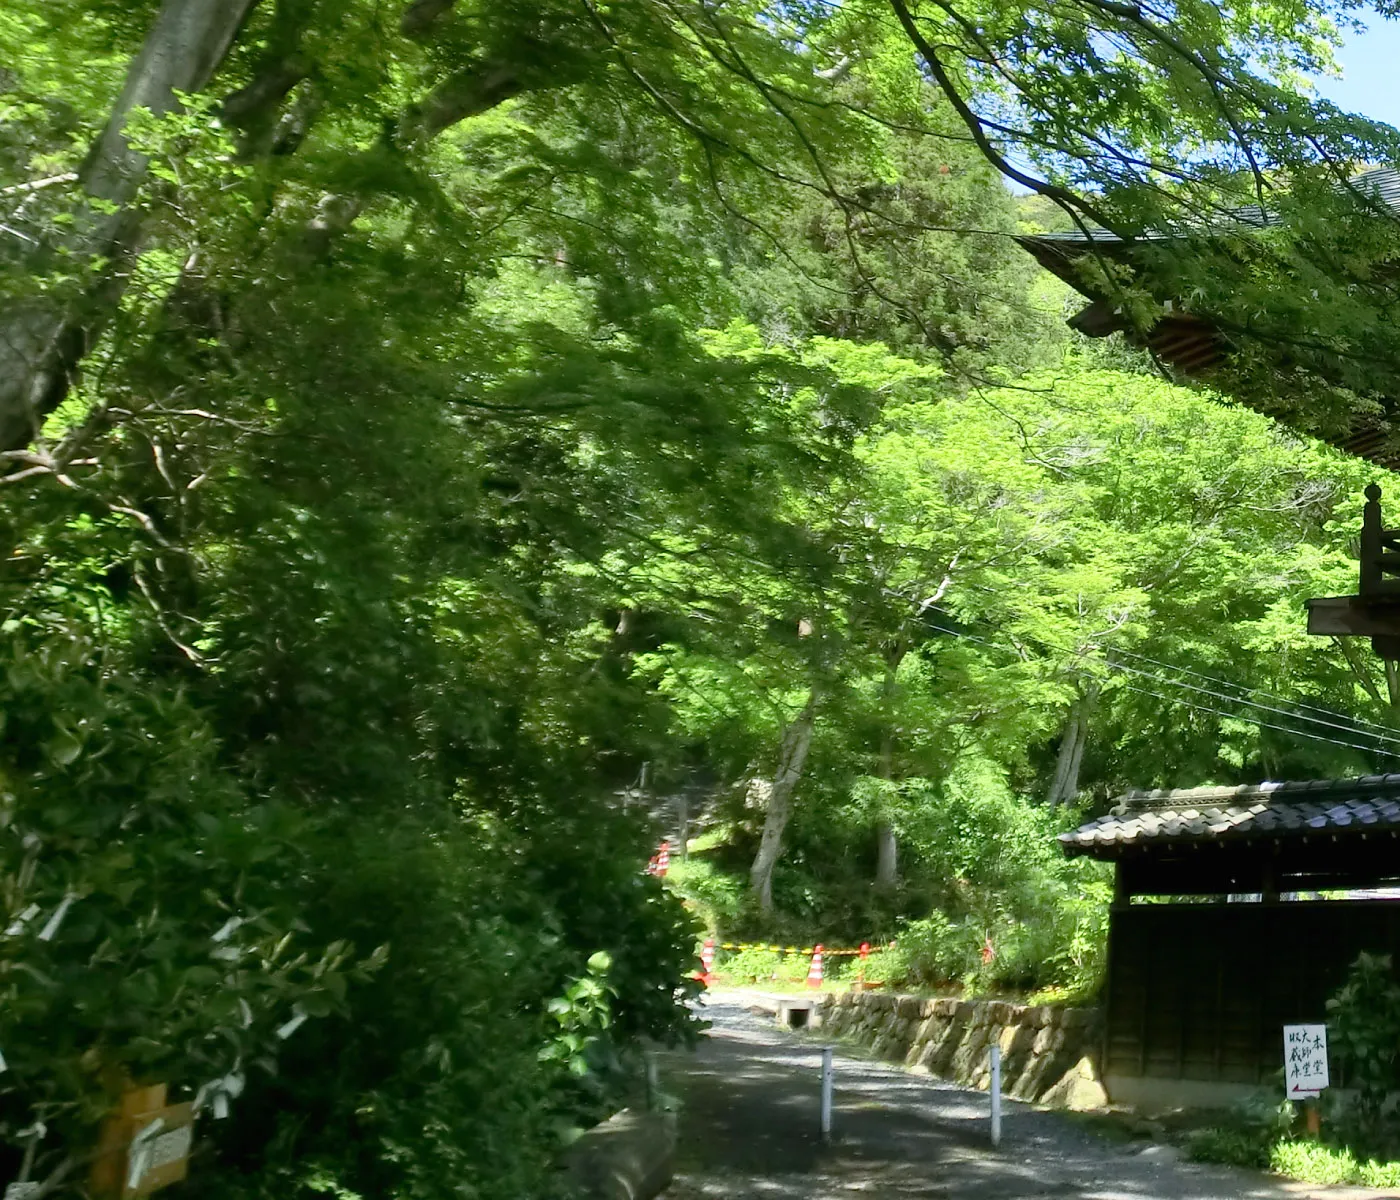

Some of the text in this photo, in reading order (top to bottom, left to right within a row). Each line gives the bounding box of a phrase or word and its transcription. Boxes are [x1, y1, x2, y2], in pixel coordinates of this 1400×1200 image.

[1301, 1028, 1312, 1077] 大師堂
[1312, 1034, 1324, 1075] 本堂
